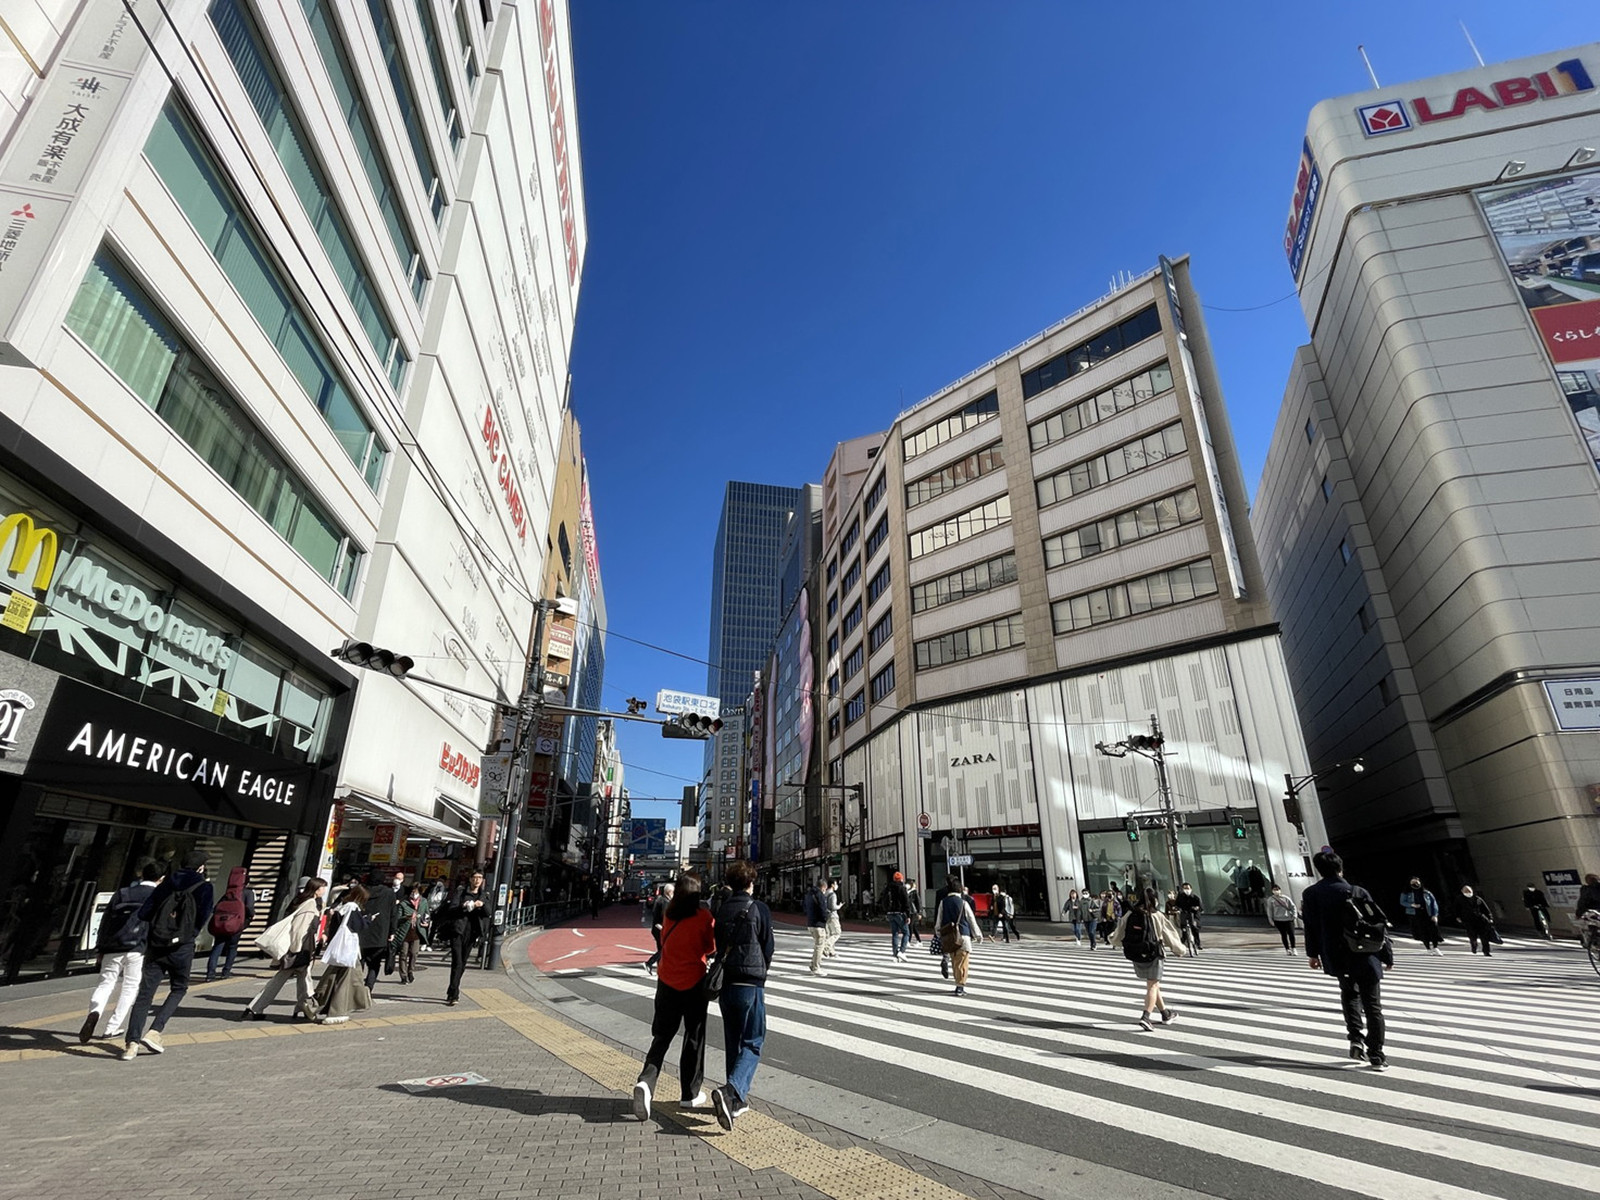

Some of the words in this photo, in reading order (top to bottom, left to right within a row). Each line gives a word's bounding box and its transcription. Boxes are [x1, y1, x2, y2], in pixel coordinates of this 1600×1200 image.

[1409, 57, 1597, 126] LABI1
[42, 103, 90, 161] 大成有楽
[0, 218, 27, 272] 三菱地所
[482, 403, 500, 465] BIC
[497, 453, 527, 548] CAMERA
[57, 556, 232, 672] McDonald's
[663, 693, 717, 710] 池袋駅東口北
[1563, 687, 1594, 696] 日用品
[67, 722, 229, 789] AMERICAN
[238, 770, 295, 806] EAGLE
[439, 741, 480, 789] ビックカメラ
[950, 752, 997, 768] ZARA
[966, 829, 990, 837] ZARA
